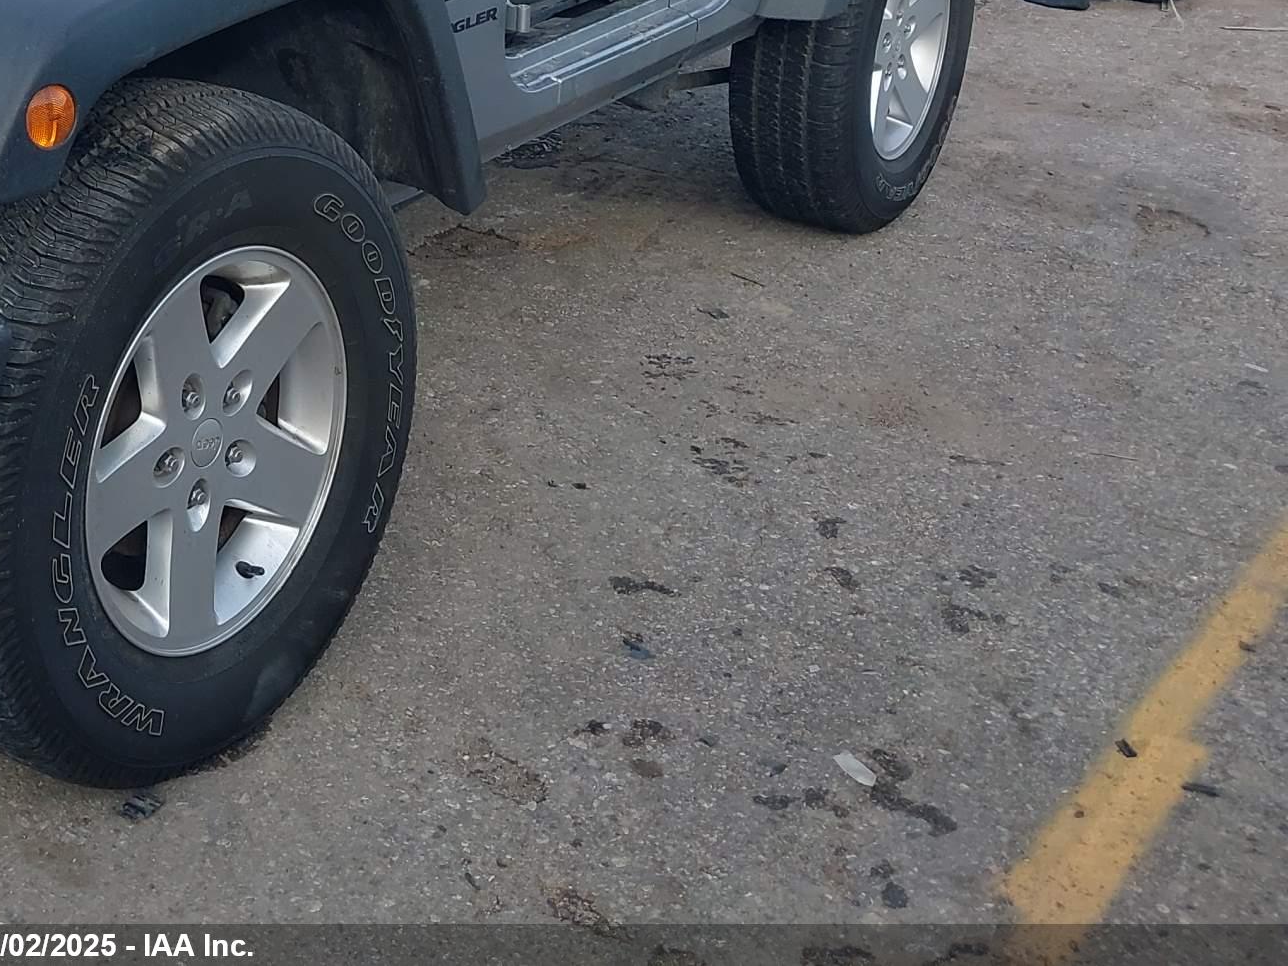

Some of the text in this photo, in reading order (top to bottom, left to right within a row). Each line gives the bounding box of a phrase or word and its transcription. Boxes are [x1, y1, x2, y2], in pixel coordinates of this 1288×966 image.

[451, 7, 498, 33] GLER
[313, 192, 405, 534] GOODYEAR
[52, 374, 166, 738] WRANGLER
